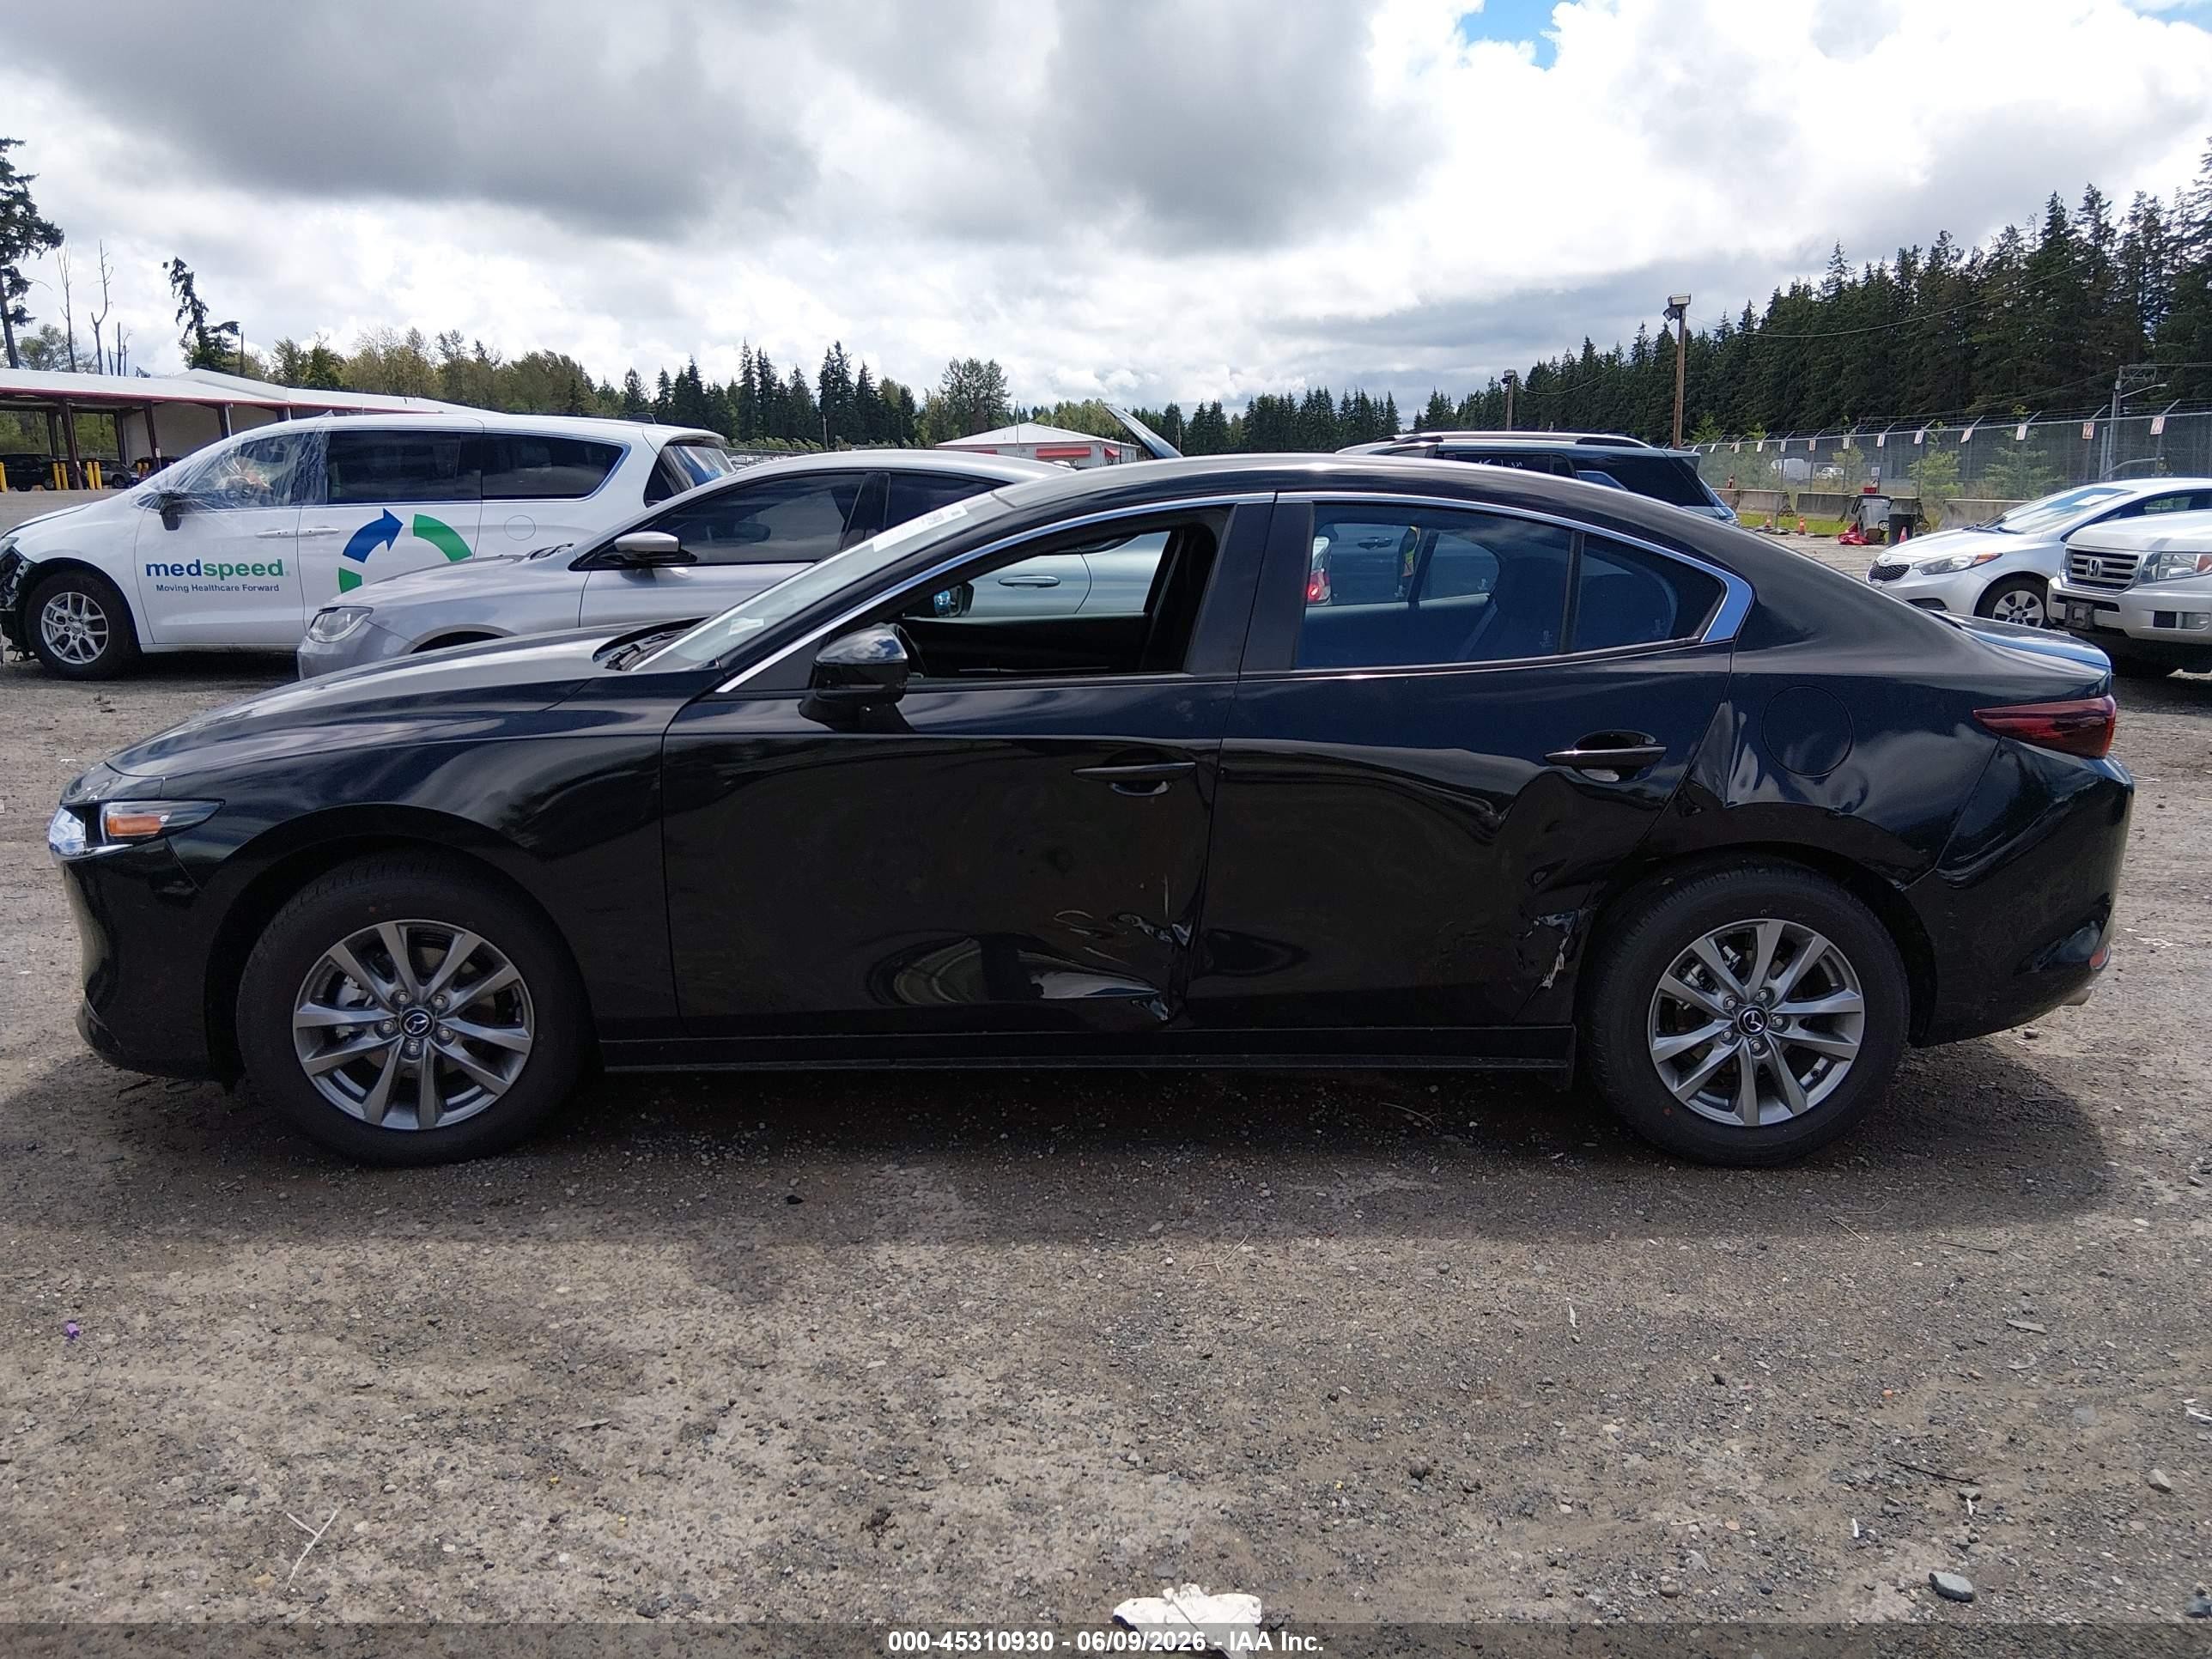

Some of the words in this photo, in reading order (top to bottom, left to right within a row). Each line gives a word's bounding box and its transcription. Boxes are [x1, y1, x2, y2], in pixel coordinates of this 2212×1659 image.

[2083, 423, 2093, 438] 22
[145, 559, 283, 581] medspeed
[156, 584, 190, 593] Moving
